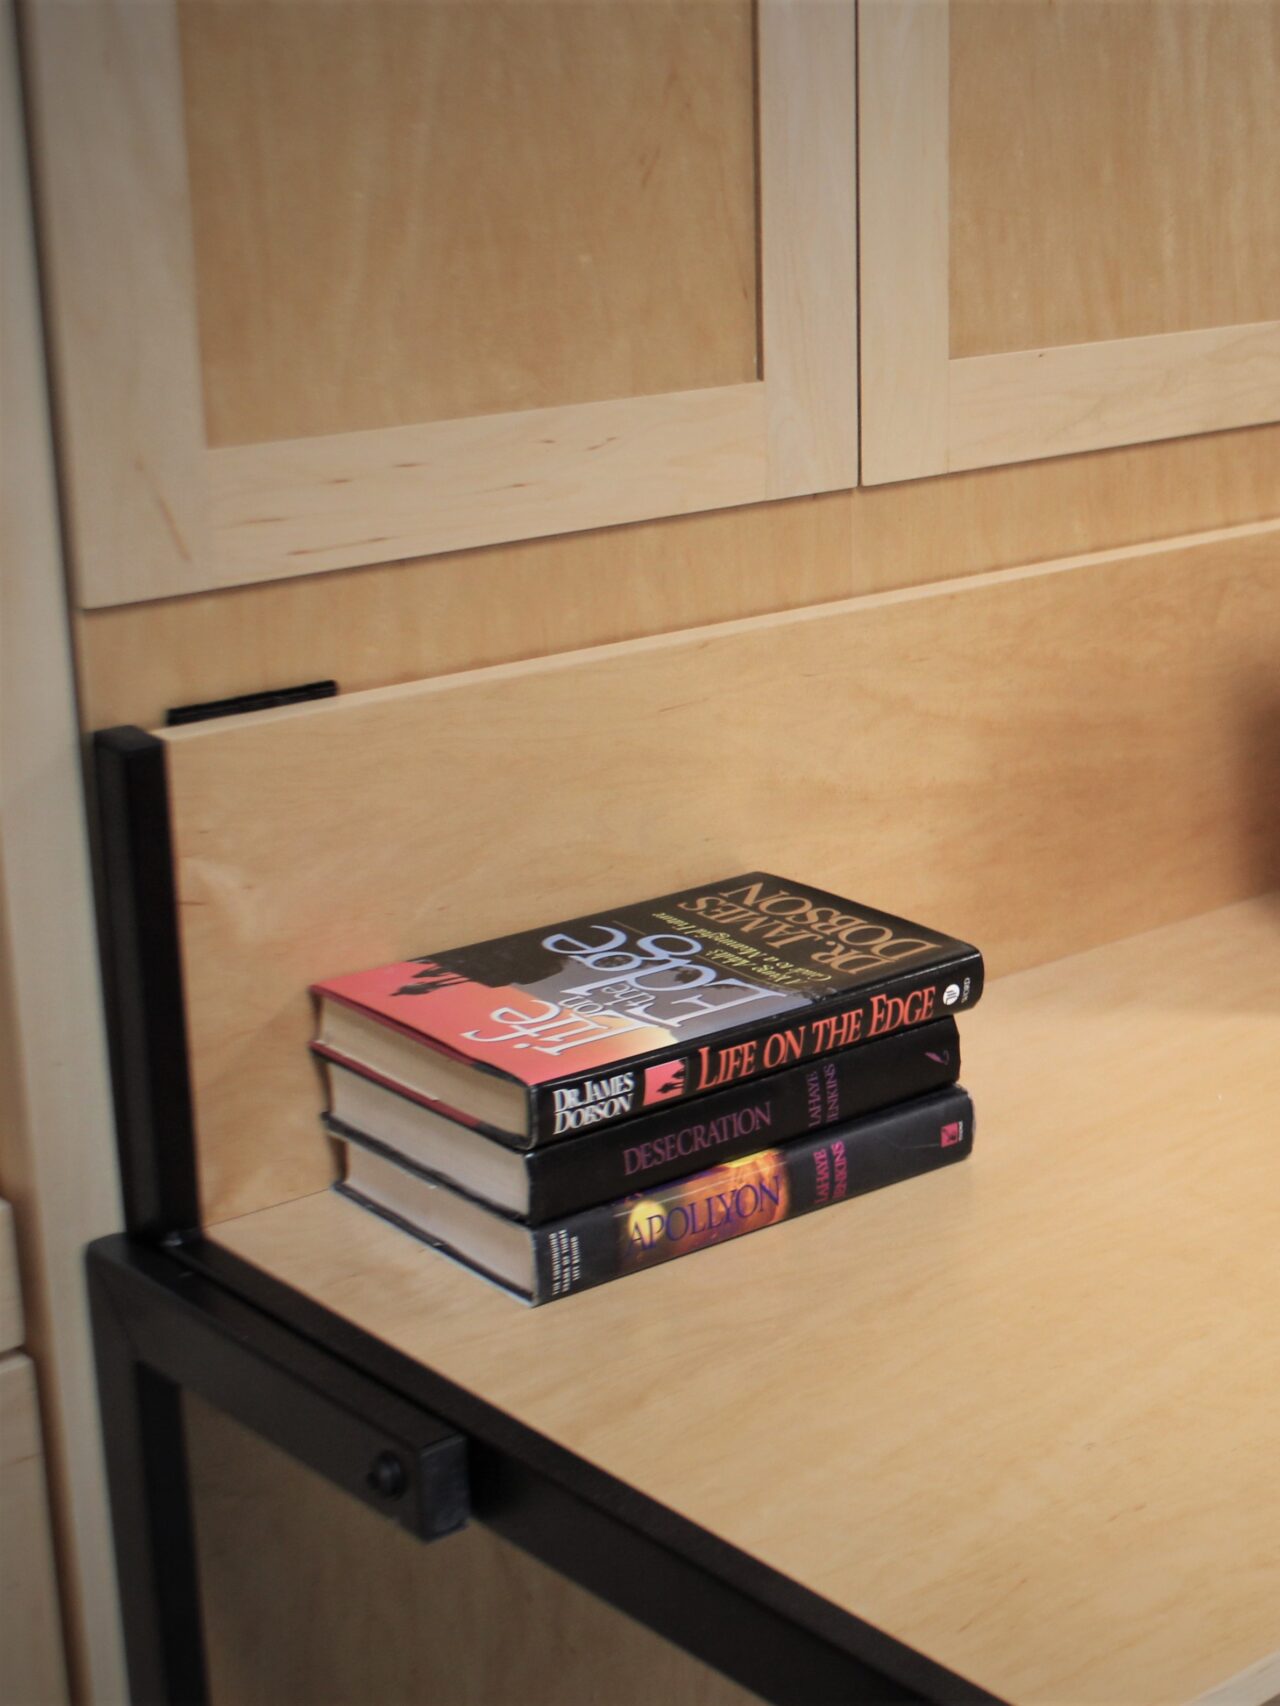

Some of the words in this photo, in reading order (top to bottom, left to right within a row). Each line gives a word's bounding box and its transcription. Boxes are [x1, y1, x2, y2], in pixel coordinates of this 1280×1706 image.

[678, 896, 824, 949] JAMES
[719, 882, 943, 961] DOBSON
[542, 925, 788, 1028] Edge
[811, 940, 898, 975] DR.
[558, 995, 604, 1015] on
[601, 983, 656, 1007] the
[460, 999, 659, 1056] Life
[696, 1045, 758, 1091] LIFE
[762, 1026, 807, 1069] ON
[811, 1008, 864, 1055] THE
[868, 985, 937, 1038] EDGE
[552, 1092, 635, 1135] DOBSON
[583, 1071, 635, 1105] JAMES
[823, 1063, 839, 1124] JENKINS
[623, 1102, 772, 1176] DESECRATION
[831, 1140, 848, 1200] JENKINS
[628, 1174, 782, 1251] APOLLYON
